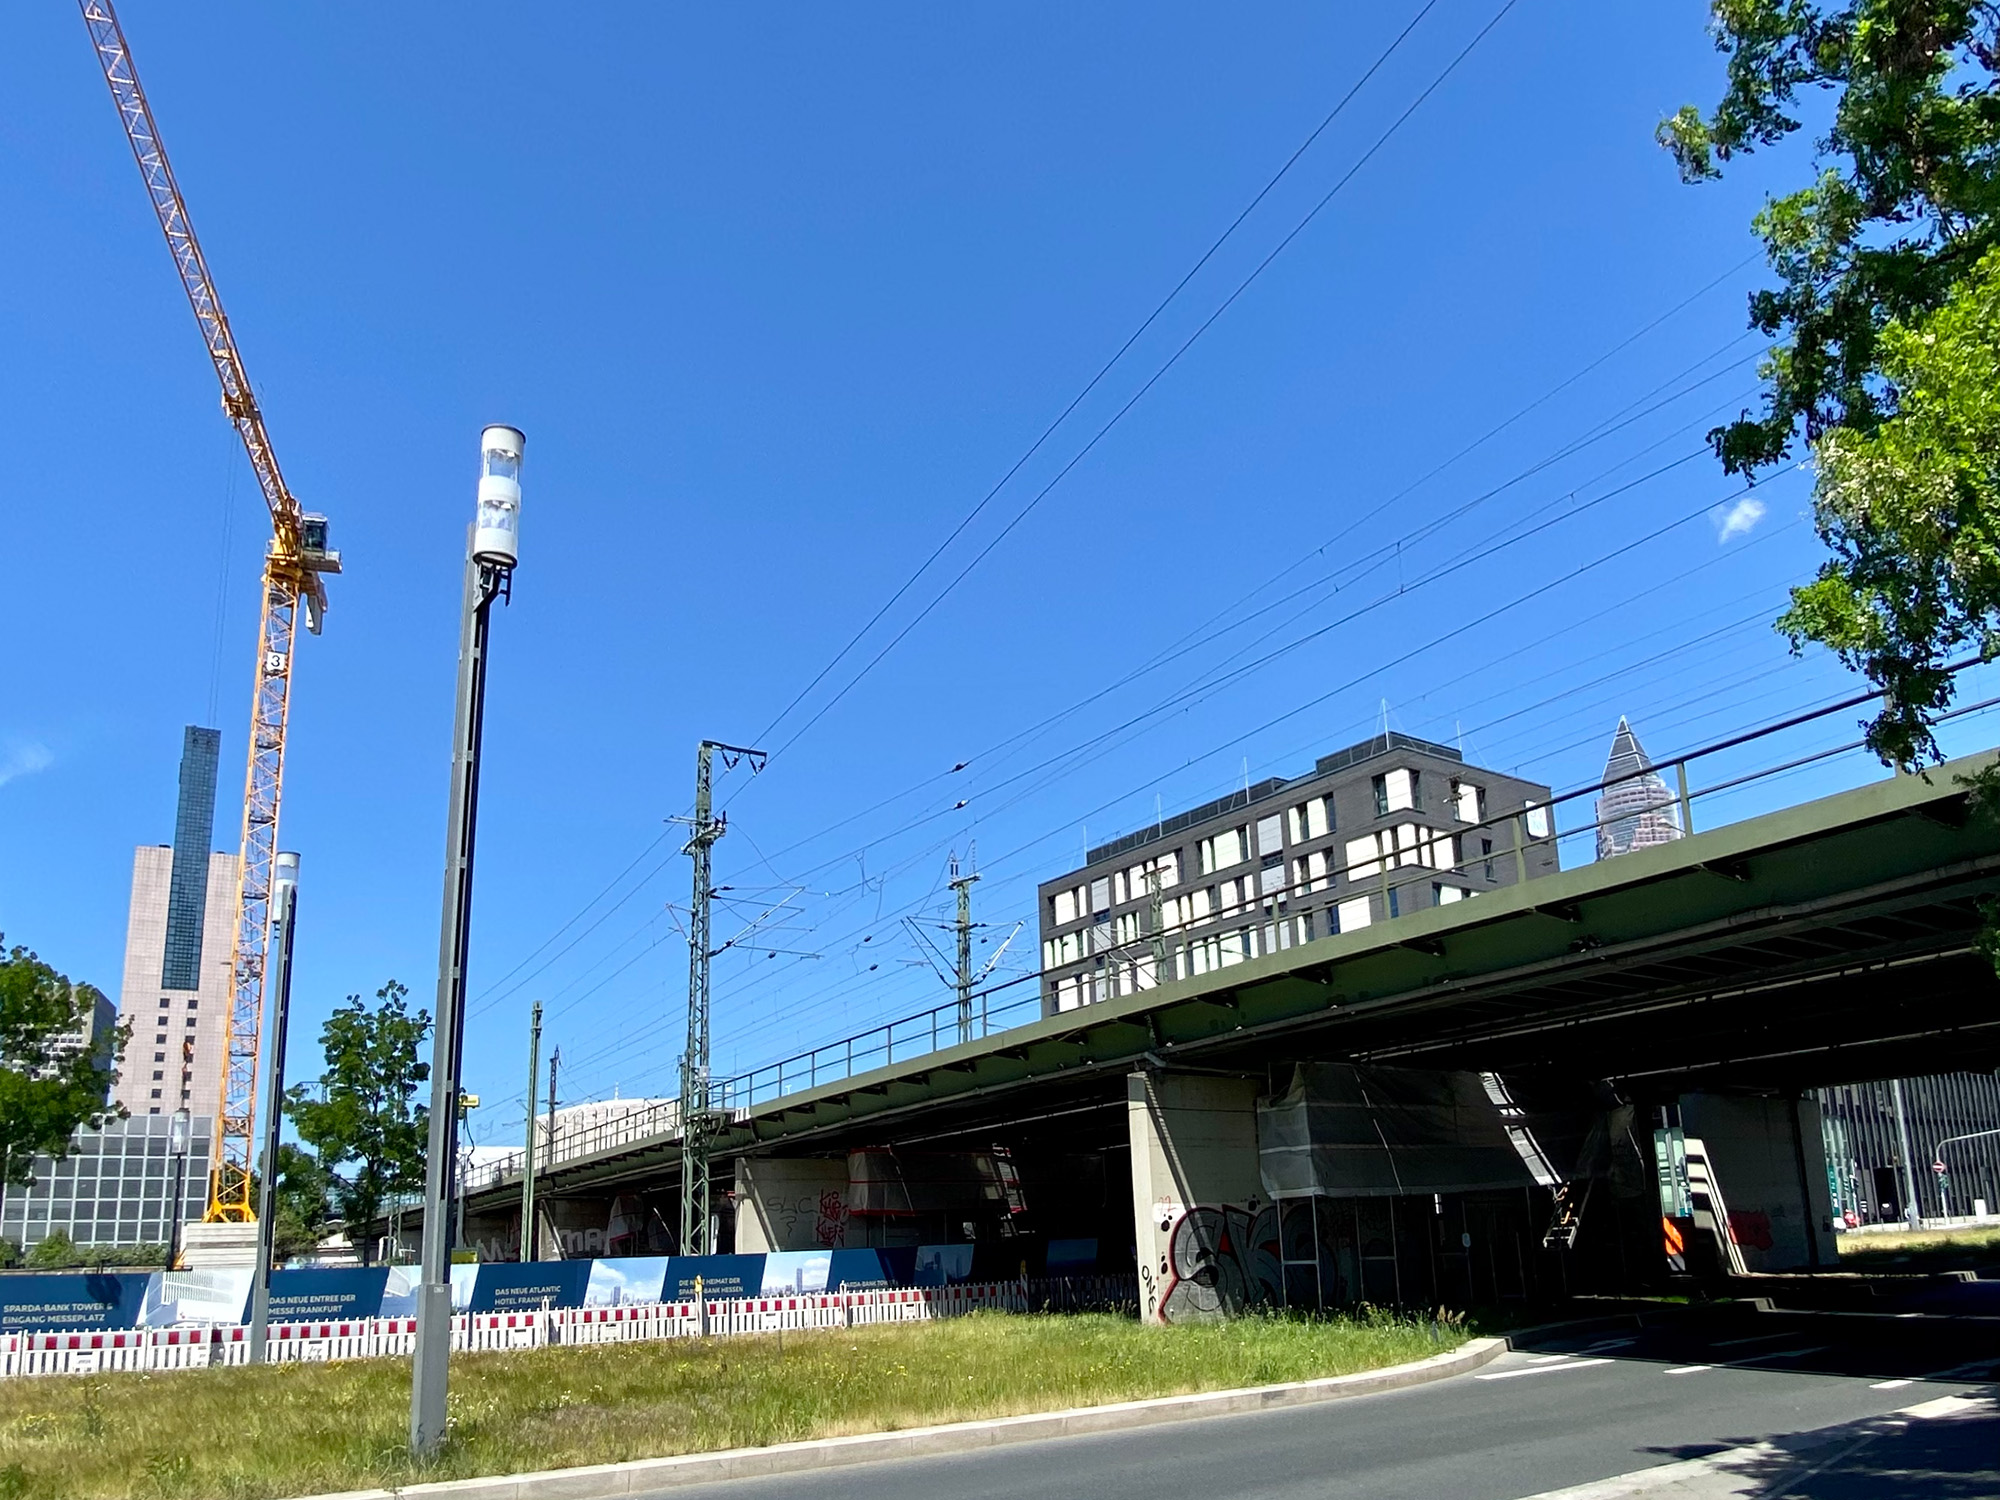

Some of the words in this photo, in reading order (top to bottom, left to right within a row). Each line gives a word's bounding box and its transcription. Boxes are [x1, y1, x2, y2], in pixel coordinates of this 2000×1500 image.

[270, 654, 281, 668] 3
[495, 1288, 510, 1296] DAS
[510, 1287, 529, 1295] NEUE
[529, 1285, 561, 1294] ATLANTIC
[269, 1296, 286, 1304] DAS
[287, 1295, 309, 1303] NEUE
[309, 1294, 339, 1302] ENTREE
[340, 1294, 356, 1302] DER
[3, 1303, 70, 1313] SPARDA-BANK
[72, 1302, 105, 1311] TOWER
[268, 1306, 295, 1315] MESSE
[296, 1304, 343, 1314] FRANKFURT
[2, 1315, 46, 1324] EINGANG
[47, 1313, 105, 1323] MESSEPLATZ
